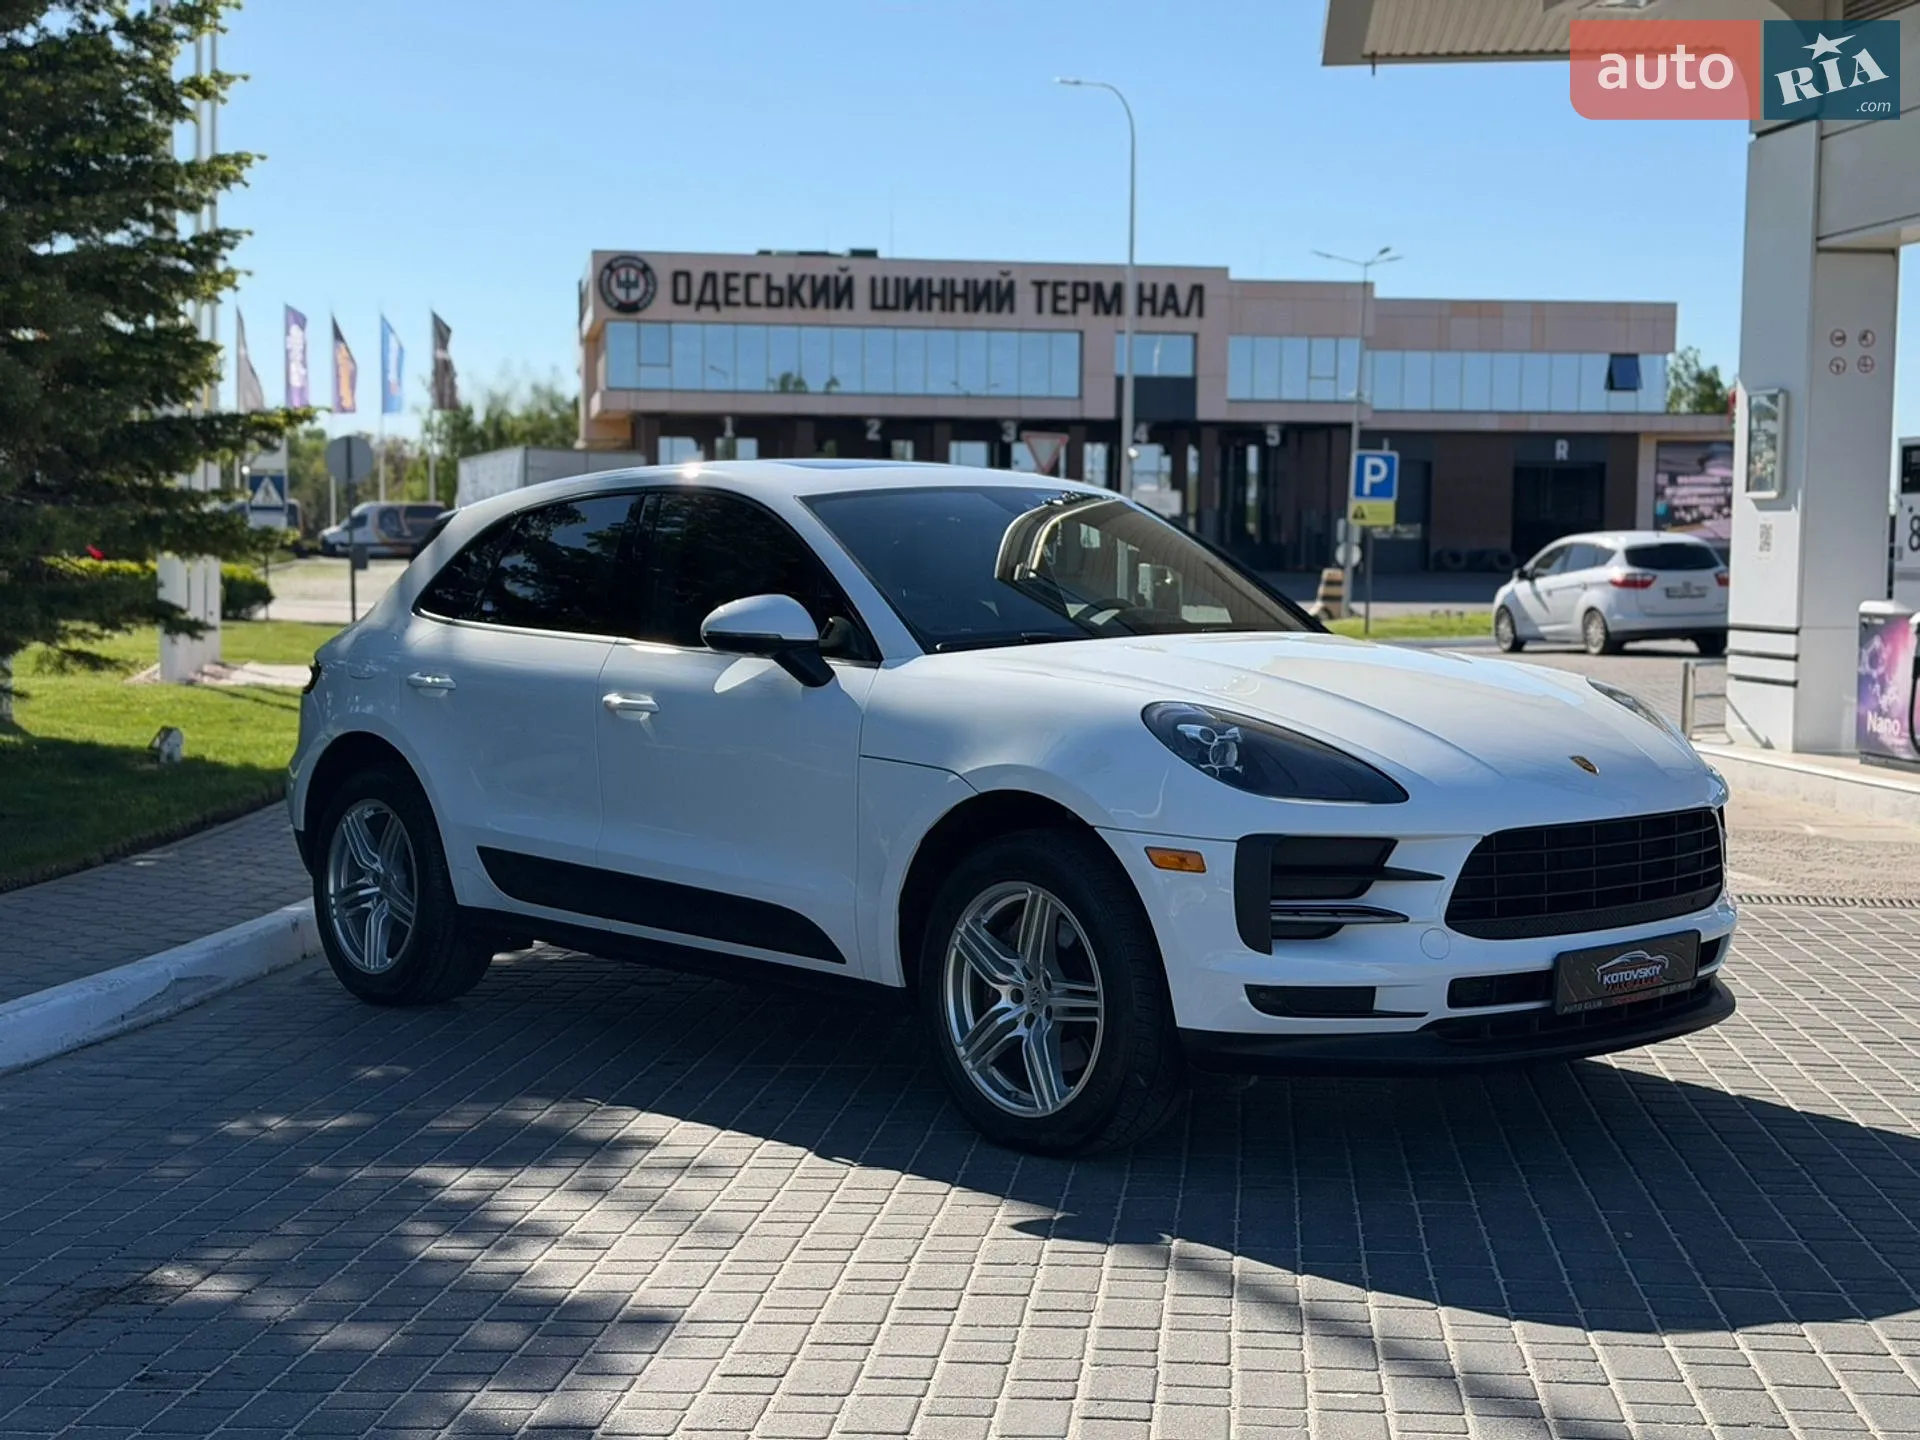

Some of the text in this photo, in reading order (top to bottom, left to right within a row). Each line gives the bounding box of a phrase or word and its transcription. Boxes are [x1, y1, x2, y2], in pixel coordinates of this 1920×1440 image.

[671, 266, 854, 312] ОДЕСЬКИЙ
[869, 270, 1016, 315] ШИННИЙ
[1030, 279, 1205, 319] ТЕРМНАЛ
[866, 418, 881, 441] 2
[1001, 420, 1017, 443] 3
[1134, 423, 1149, 443] 4
[1266, 424, 1281, 446] 5
[1555, 439, 1569, 460] R
[1362, 457, 1389, 495] P
[1866, 710, 1902, 736] Nano
[1602, 965, 1662, 985] KOTOVSKIY
